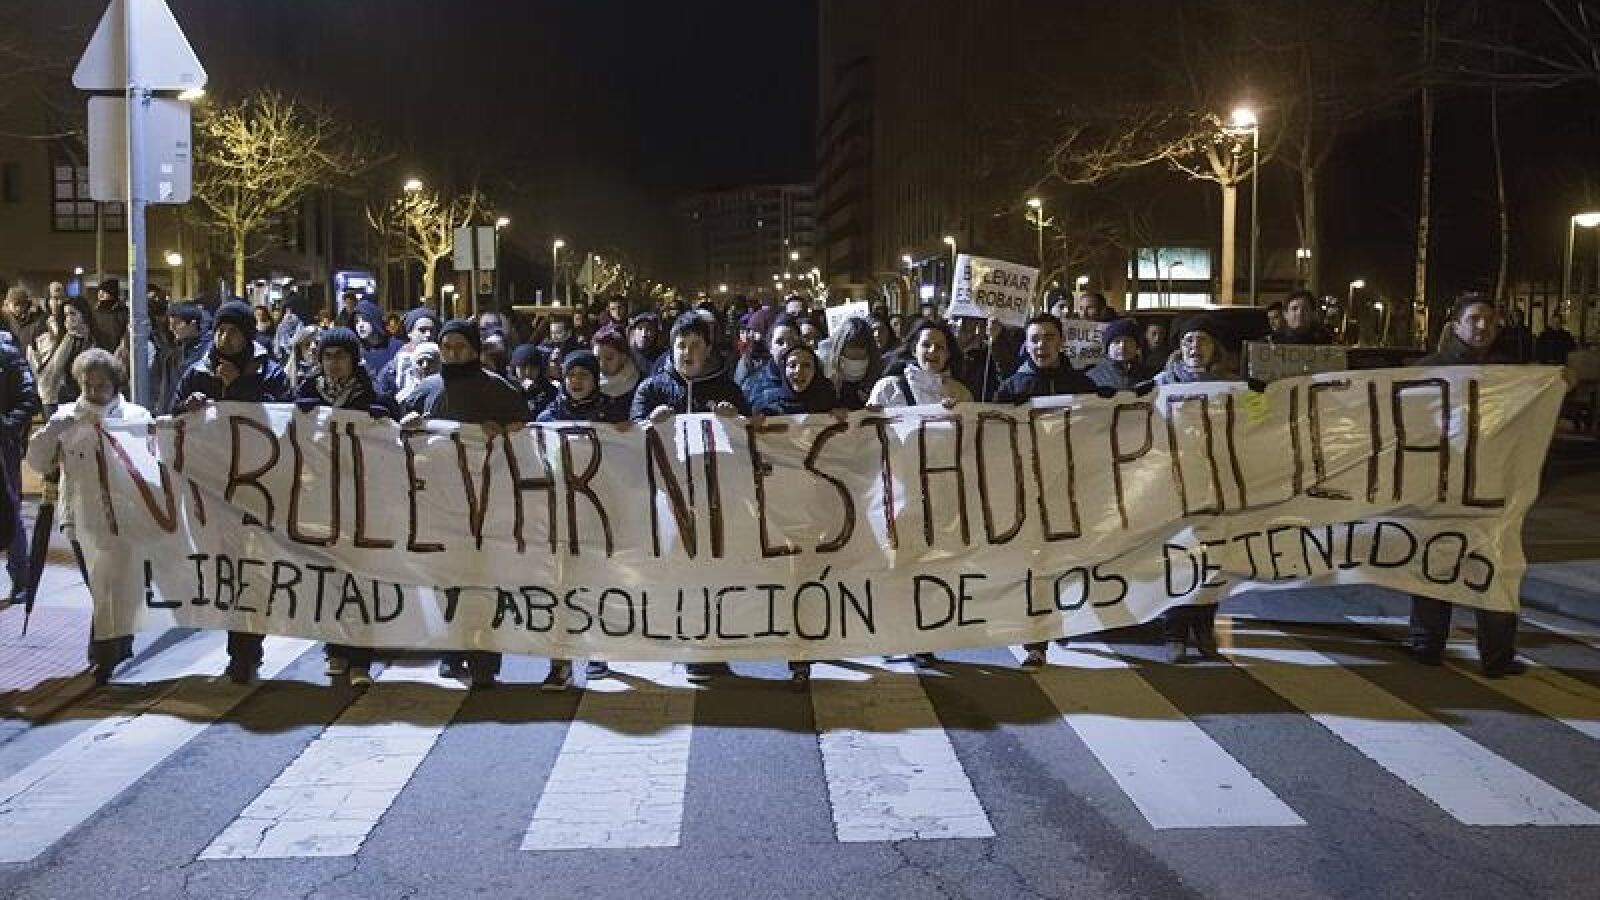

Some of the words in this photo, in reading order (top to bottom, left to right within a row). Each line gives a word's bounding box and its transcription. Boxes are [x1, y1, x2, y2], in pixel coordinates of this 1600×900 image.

[963, 264, 1031, 290] BLEVAR
[224, 415, 614, 556] BULEVAR
[645, 419, 724, 560] NI
[746, 405, 1082, 558] ESTADO
[1110, 378, 1505, 530] POLICIAL
[144, 553, 404, 624] LIBERTAD
[491, 565, 876, 641] ABSOLUCIÓN
[912, 575, 987, 630] DE
[1026, 565, 1129, 616] LOS
[1163, 520, 1494, 599] DETENIDOS
